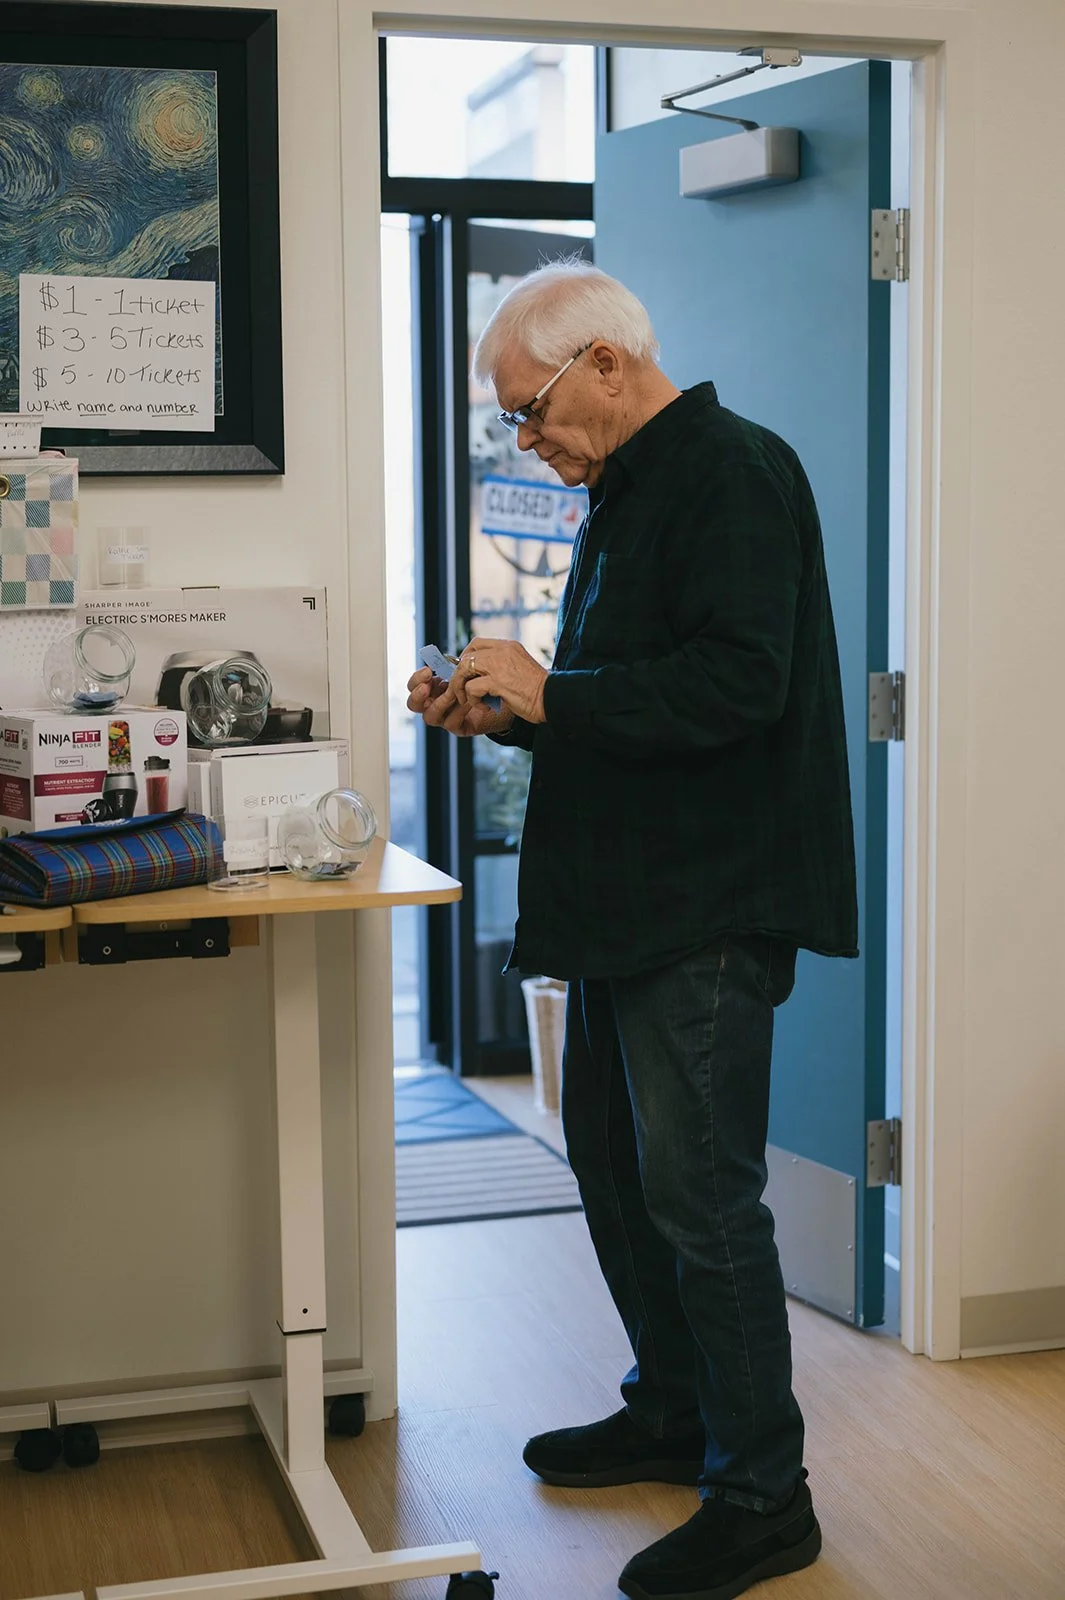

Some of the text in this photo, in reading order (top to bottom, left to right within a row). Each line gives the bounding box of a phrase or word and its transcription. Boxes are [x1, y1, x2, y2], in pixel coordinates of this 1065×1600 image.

[128, 326, 204, 349] Tickets
[106, 367, 126, 384] 10
[77, 402, 116, 413] name
[120, 400, 143, 412] and
[85, 612, 227, 625] ELECTRIC S'MORES MAKER
[5, 730, 18, 742] FIT
[38, 732, 70, 747] NINJA
[74, 731, 99, 743] FIT
[261, 794, 305, 806] EPICU
